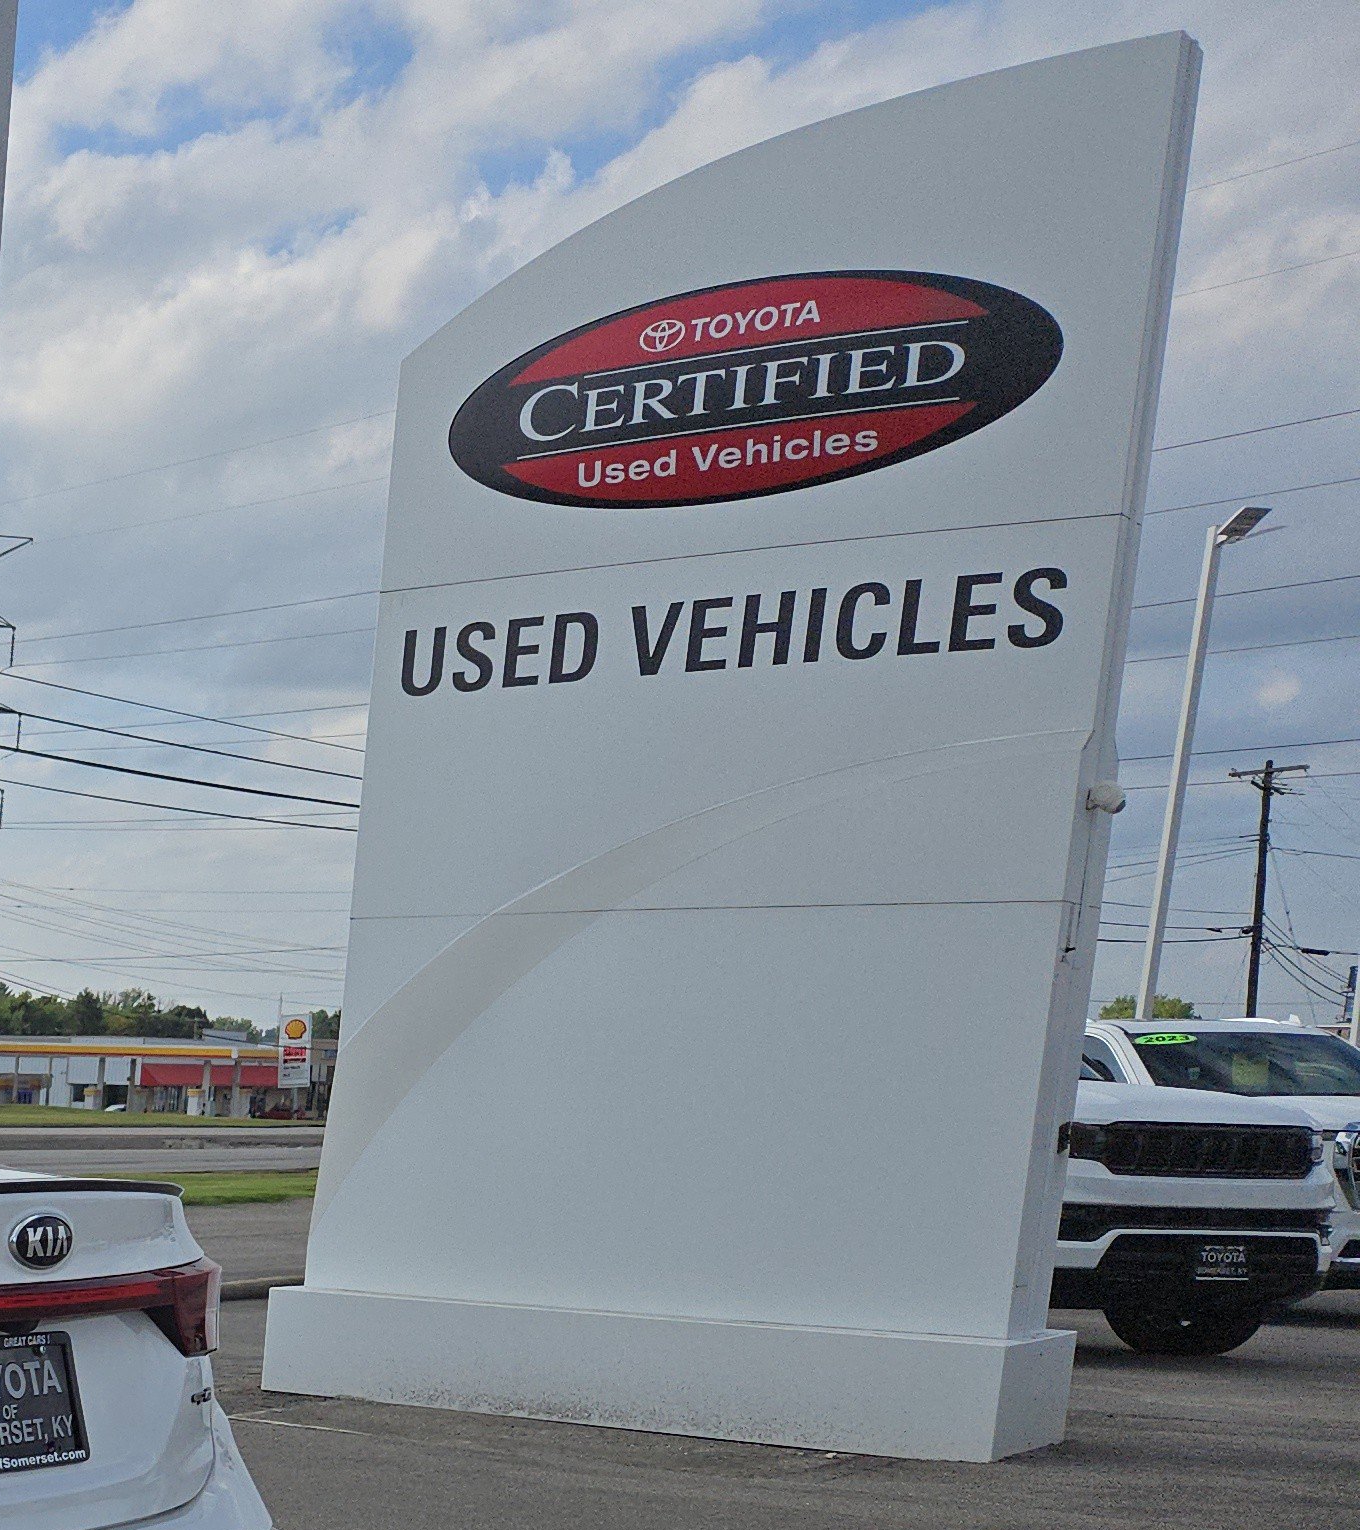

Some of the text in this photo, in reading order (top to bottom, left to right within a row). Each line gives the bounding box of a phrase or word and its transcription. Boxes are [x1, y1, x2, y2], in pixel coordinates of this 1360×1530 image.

[691, 300, 821, 342] TOYOTA
[519, 340, 967, 443] CERTIFIED
[577, 428, 879, 488] Used Vehicles
[400, 567, 1068, 697] USED VEHICLES
[26, 1225, 68, 1258] KIA
[1201, 1251, 1246, 1263] TOYOTA
[3, 1336, 26, 1348] GREAT
[3, 1404, 18, 1420] OF
[52, 1414, 75, 1438] KY
